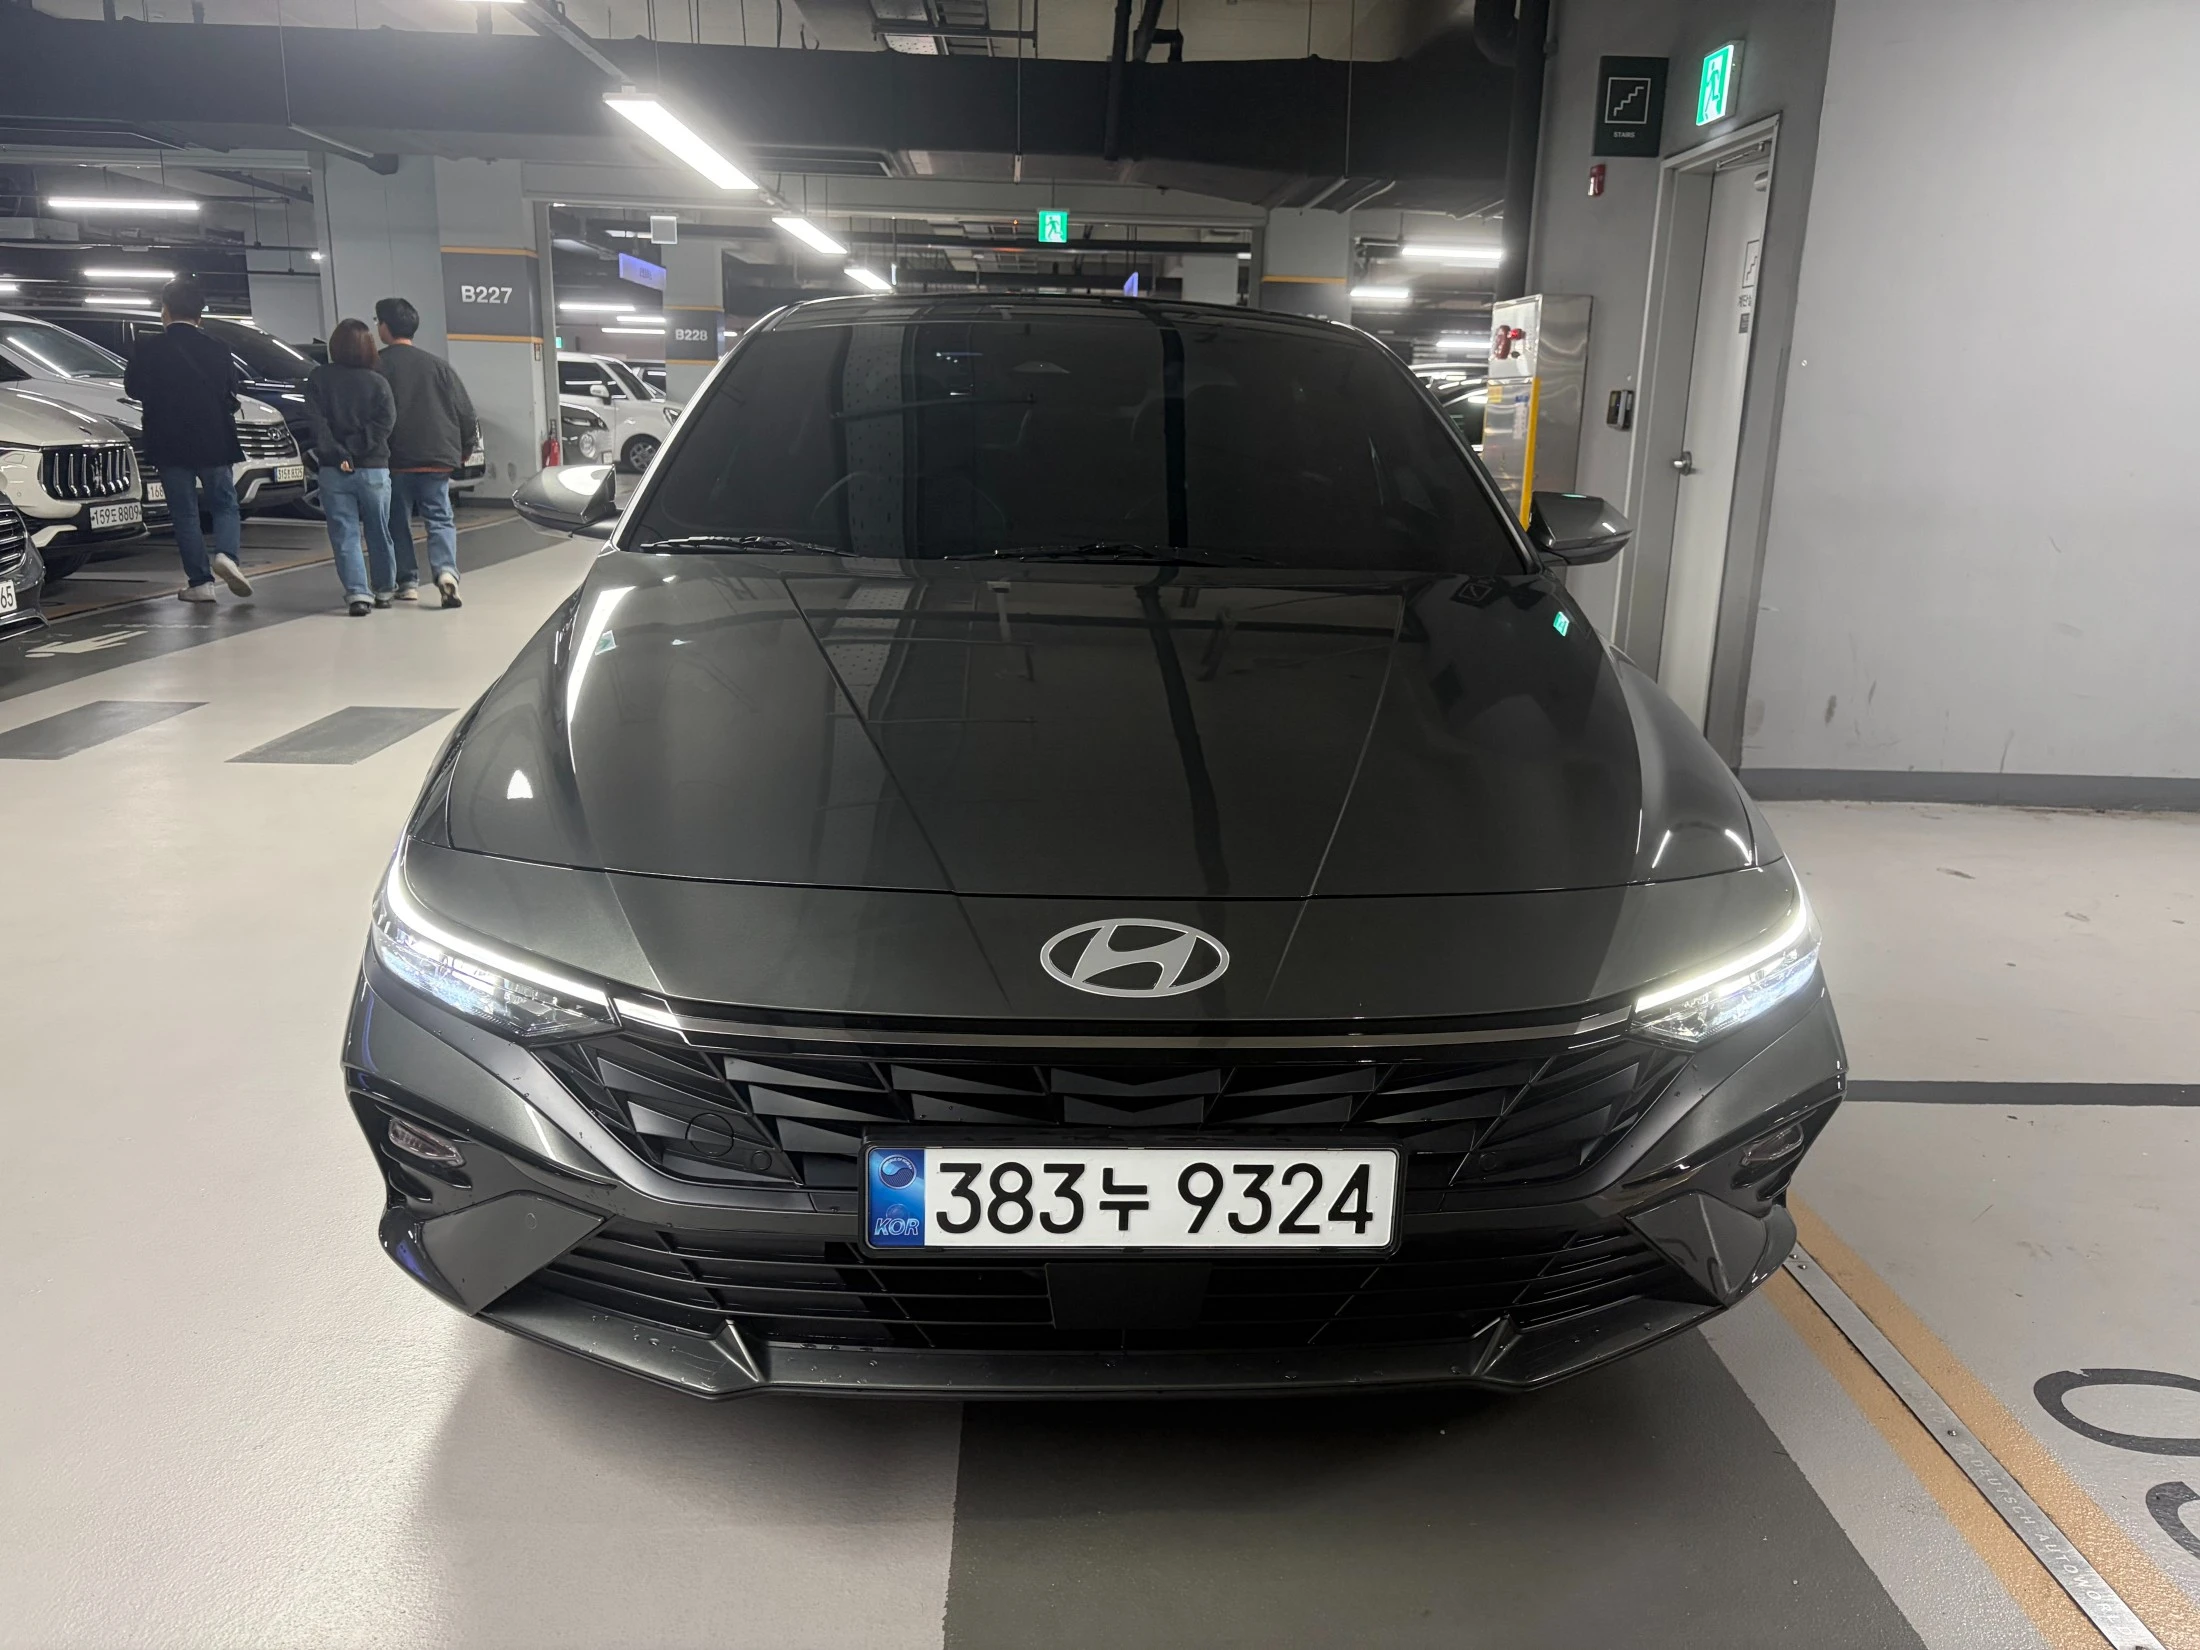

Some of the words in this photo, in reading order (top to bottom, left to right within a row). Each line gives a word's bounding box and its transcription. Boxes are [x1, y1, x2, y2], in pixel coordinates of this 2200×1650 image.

[461, 285, 513, 304] B227
[675, 329, 708, 341] B228
[0, 585, 14, 609] 65
[936, 1162, 1149, 1234] 383누
[1177, 1161, 1374, 1234] 9324
[874, 1218, 920, 1235] KOR
[1972, 1460, 2035, 1525] DEUTSCH
[2036, 1533, 2133, 1636] AUTOWORLD
